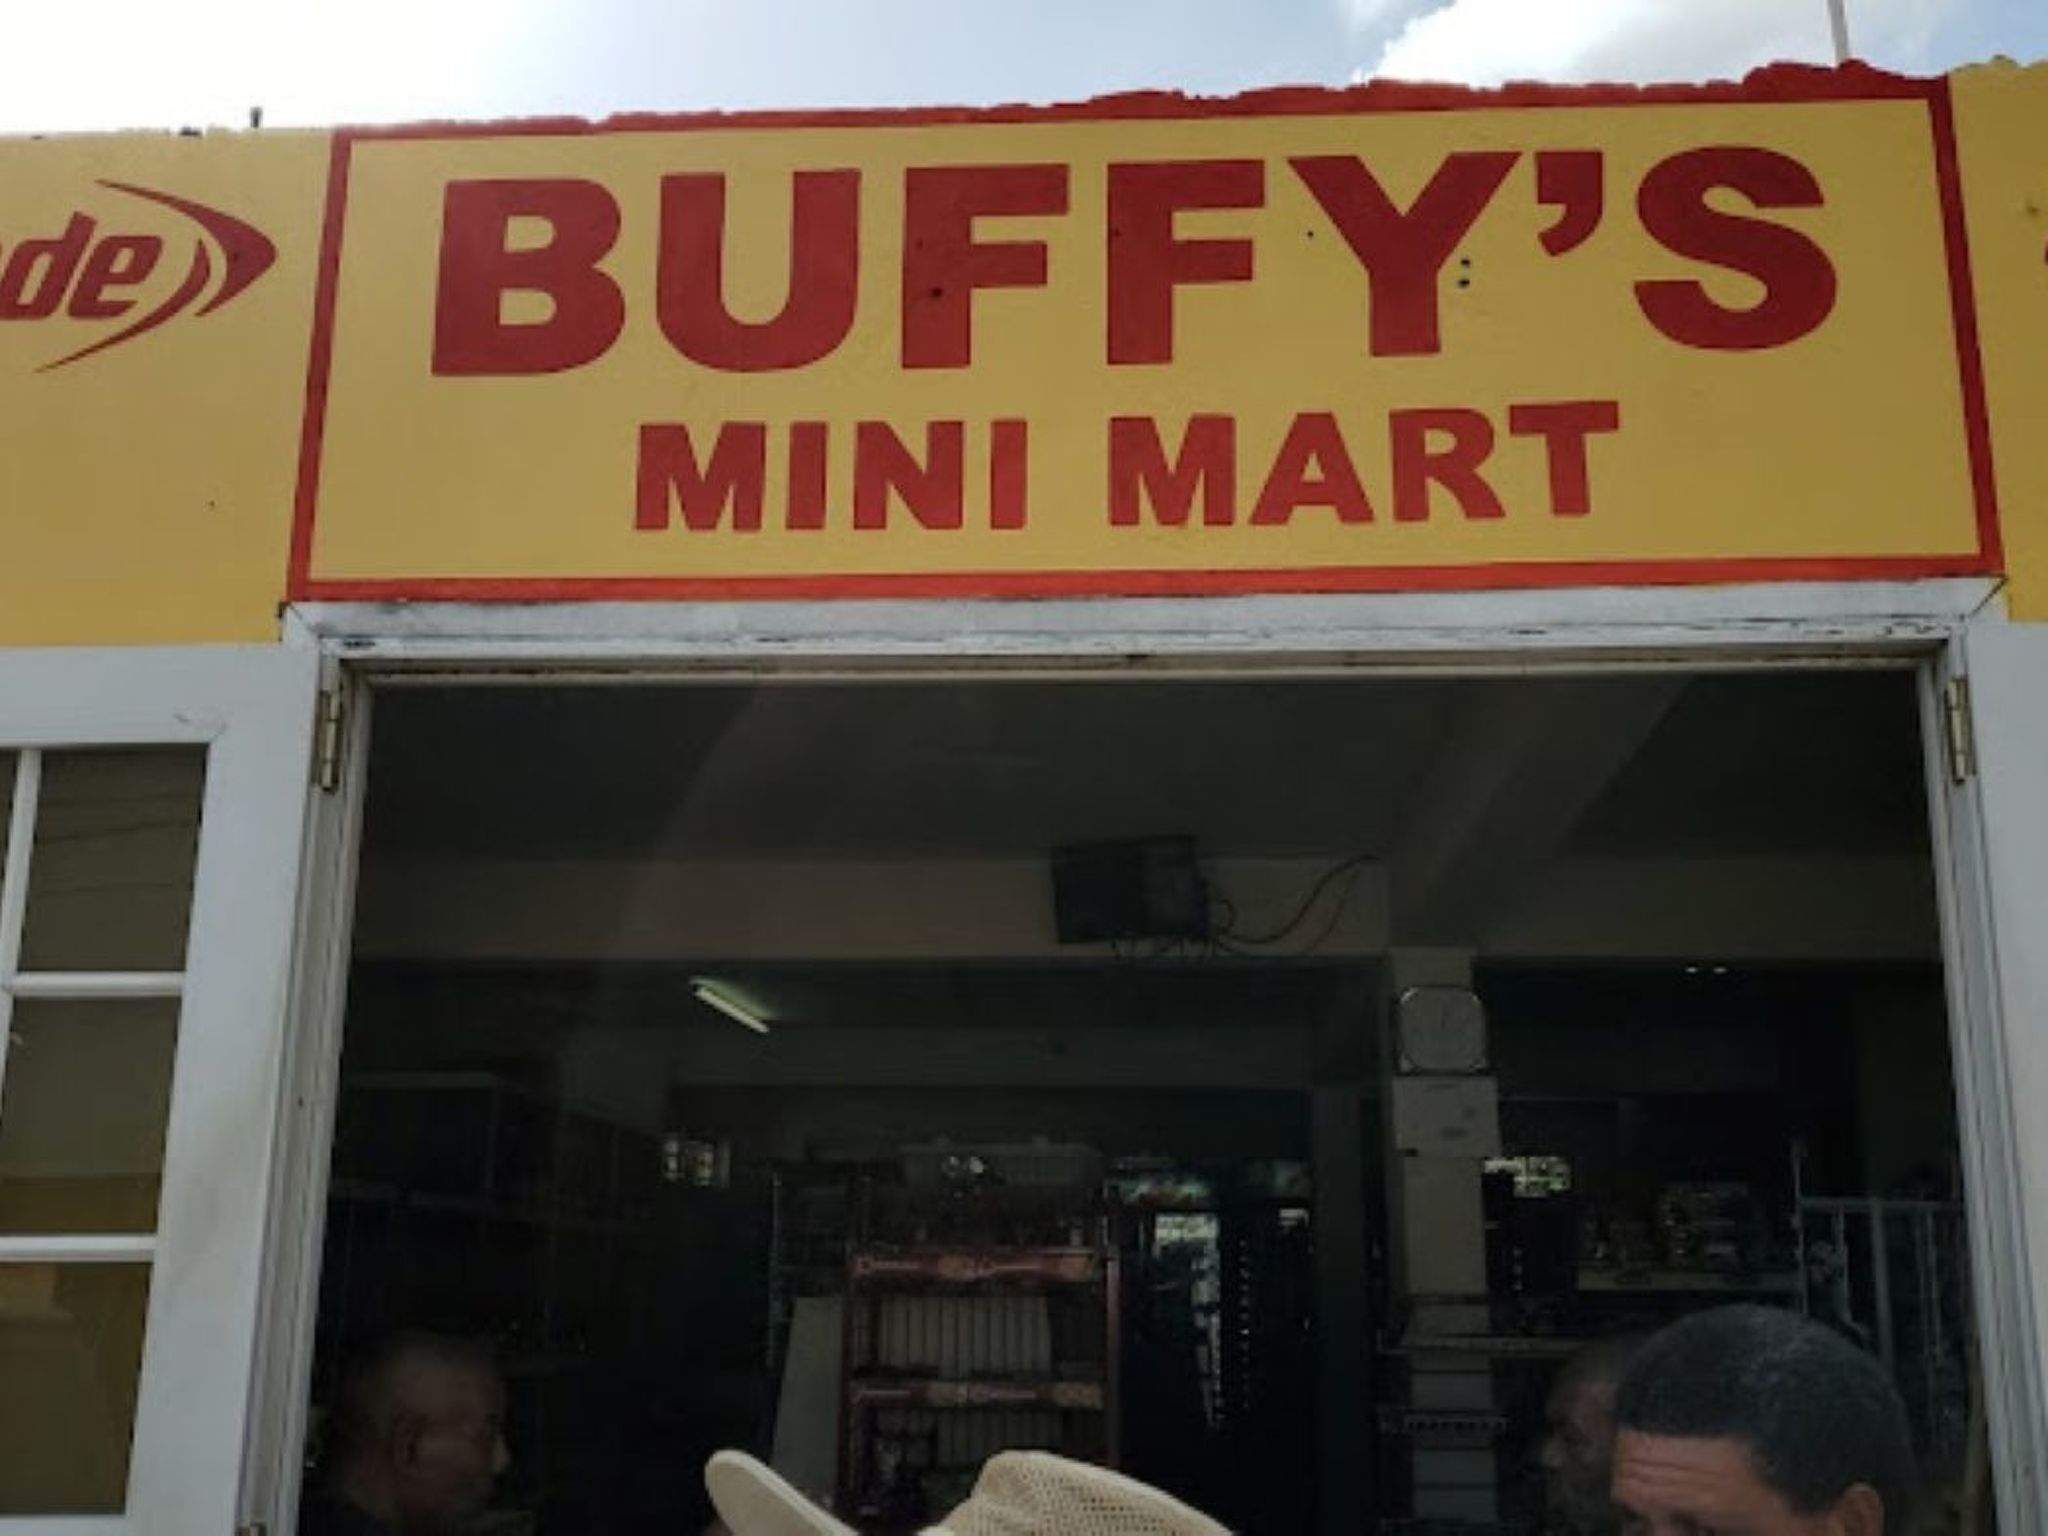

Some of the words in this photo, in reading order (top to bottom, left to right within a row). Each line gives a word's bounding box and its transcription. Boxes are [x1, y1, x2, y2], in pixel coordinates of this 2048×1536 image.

[0, 211, 163, 320] de
[433, 146, 1837, 375] BUFFY'S
[636, 419, 1026, 531] MINI
[1108, 401, 1619, 527] MART
